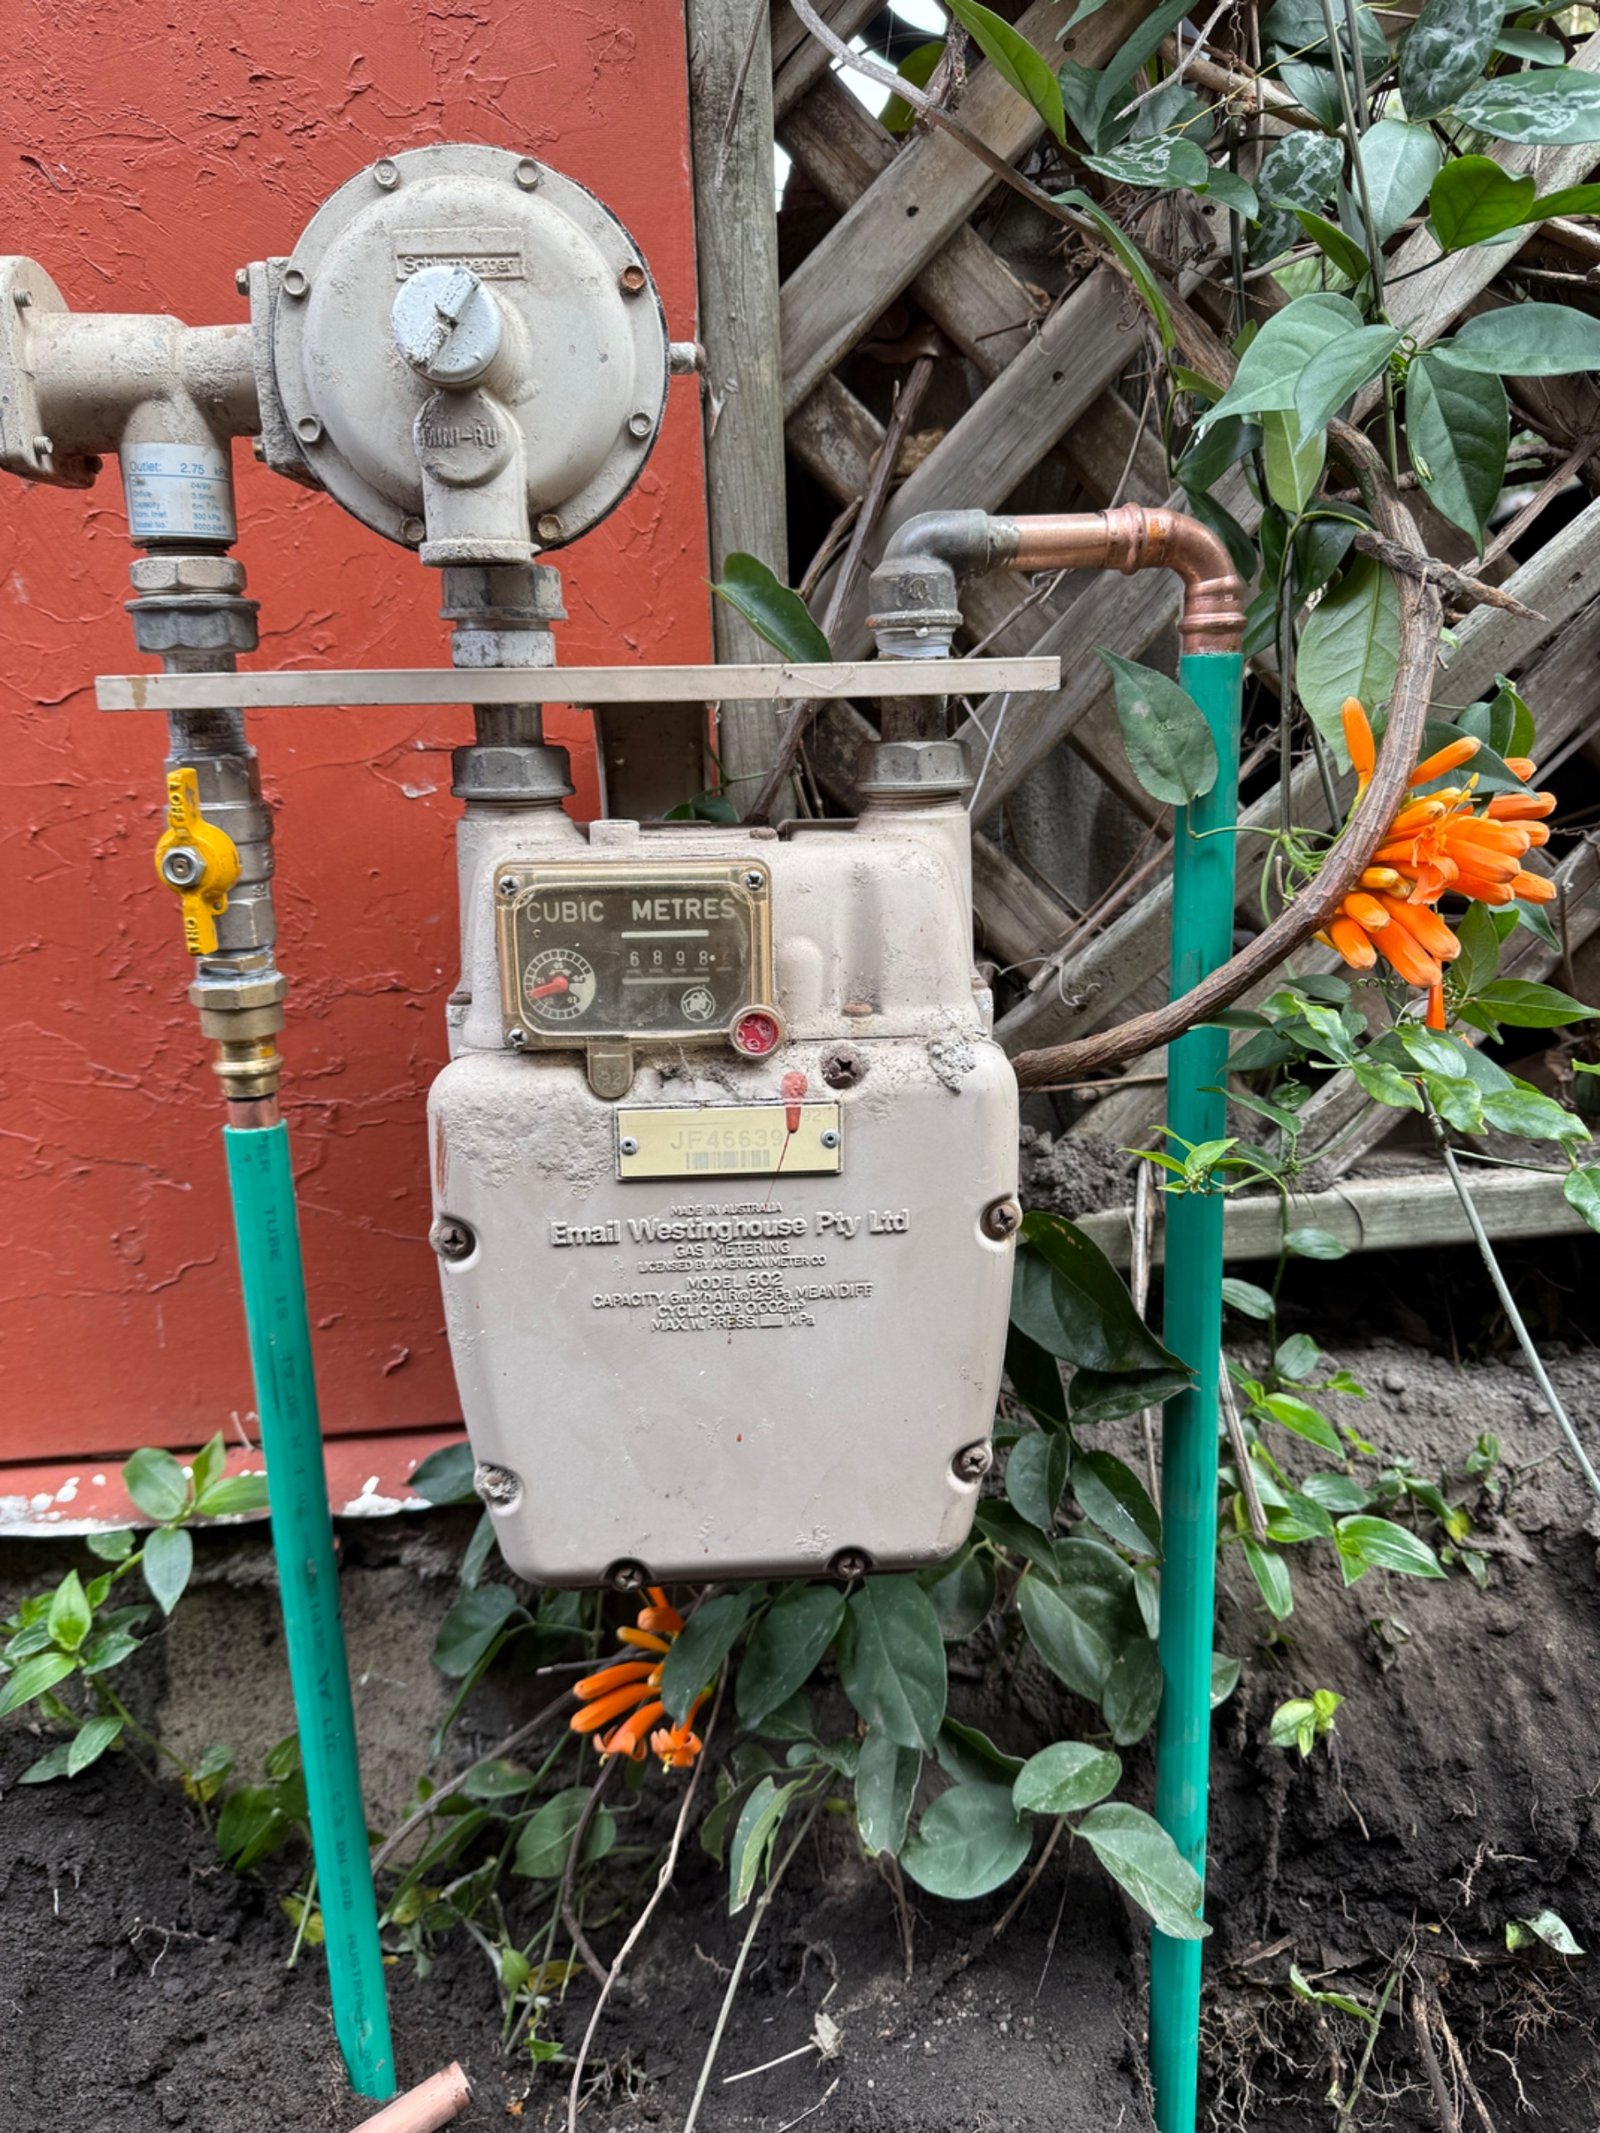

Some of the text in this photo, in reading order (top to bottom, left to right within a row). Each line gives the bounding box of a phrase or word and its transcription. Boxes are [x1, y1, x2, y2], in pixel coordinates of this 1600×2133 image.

[129, 461, 162, 473] Outlet:
[180, 462, 205, 476] 2.75
[526, 898, 736, 923] CUBIC METRES
[670, 1128, 785, 1150] JF46639
[671, 1204, 703, 1217] MADE
[722, 1202, 783, 1215] AUSTRALIA
[551, 1208, 911, 1247] Email Westinghouse Pty Ltd
[674, 1240, 791, 1259] GAS METERING
[638, 1260, 693, 1274] LICENSED
[686, 1271, 783, 1291] MODEL 602
[592, 1291, 665, 1309] CAPACITY
[657, 1303, 710, 1319] CYCLIC
[788, 1311, 816, 1327] kPa
